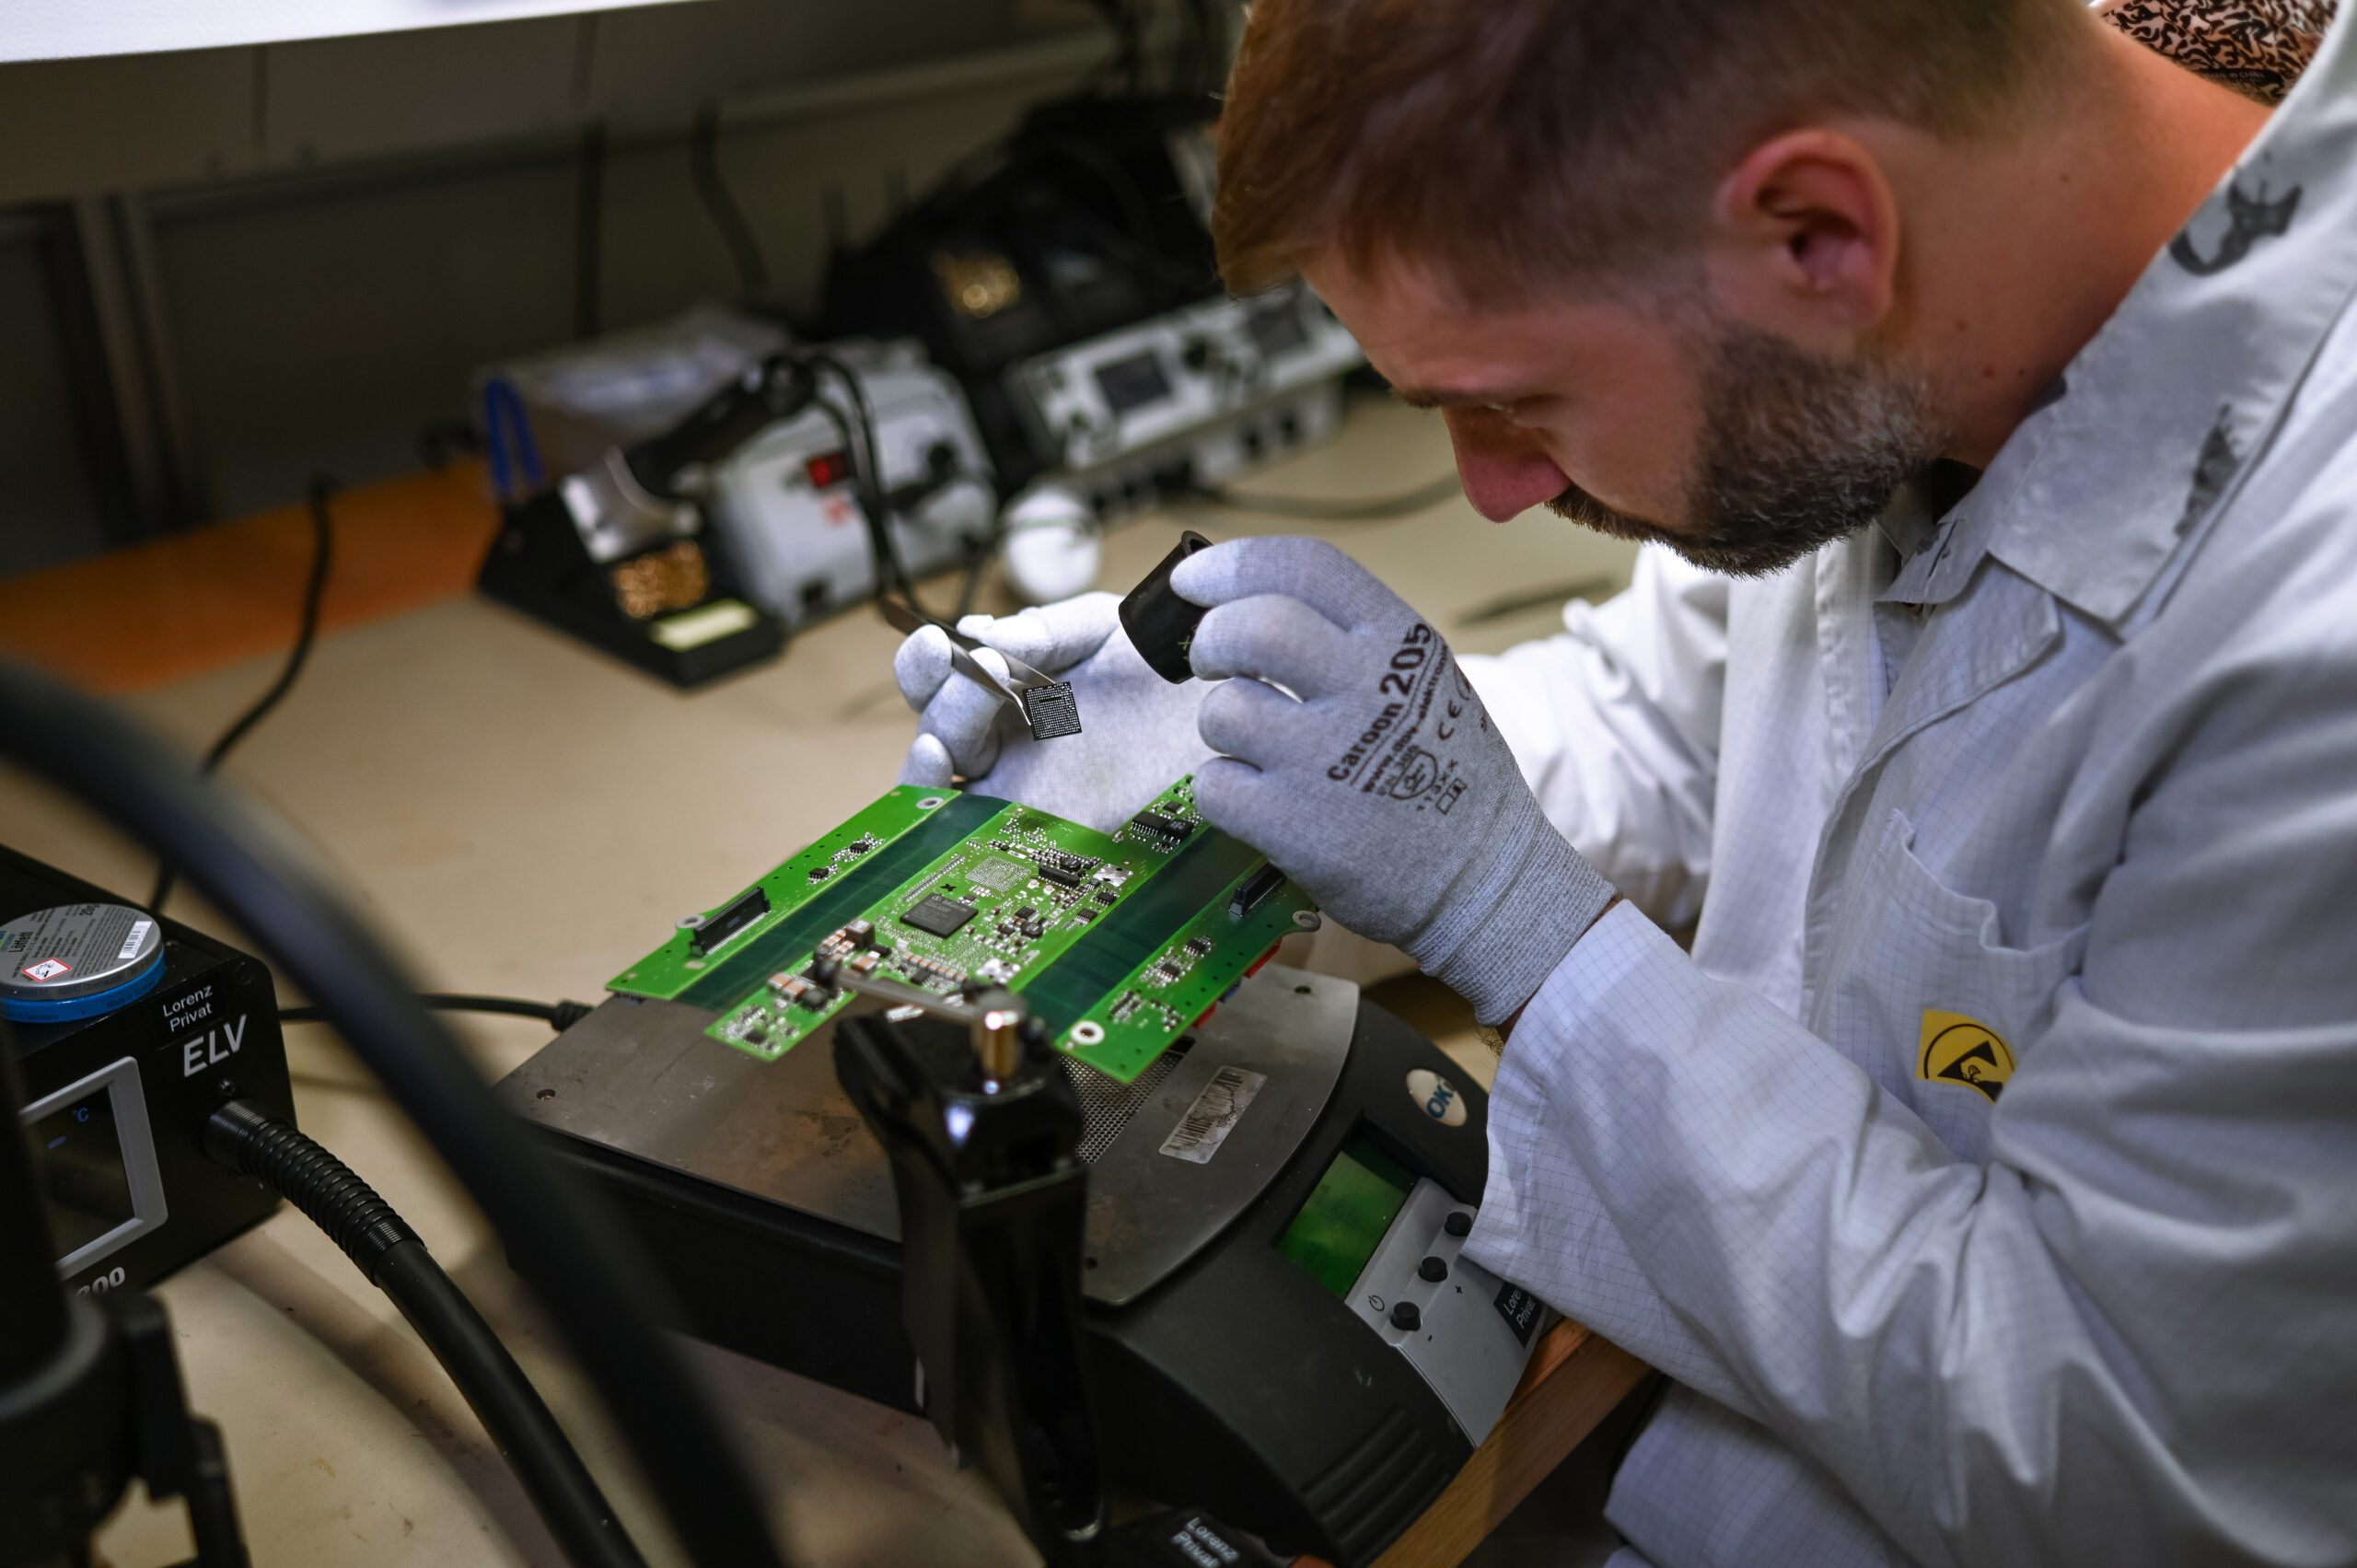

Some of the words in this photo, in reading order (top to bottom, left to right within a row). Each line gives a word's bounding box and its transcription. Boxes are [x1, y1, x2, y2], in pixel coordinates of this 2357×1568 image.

[1328, 703, 1403, 781] Caroon
[1379, 623, 1432, 695] 205
[1438, 700, 1462, 740] CE
[163, 985, 213, 1017] Lorenz
[169, 1002, 213, 1032] Privat
[184, 1014, 247, 1077] ELV
[1504, 1290, 1521, 1316] Lore
[1186, 1516, 1238, 1561] Lorenz
